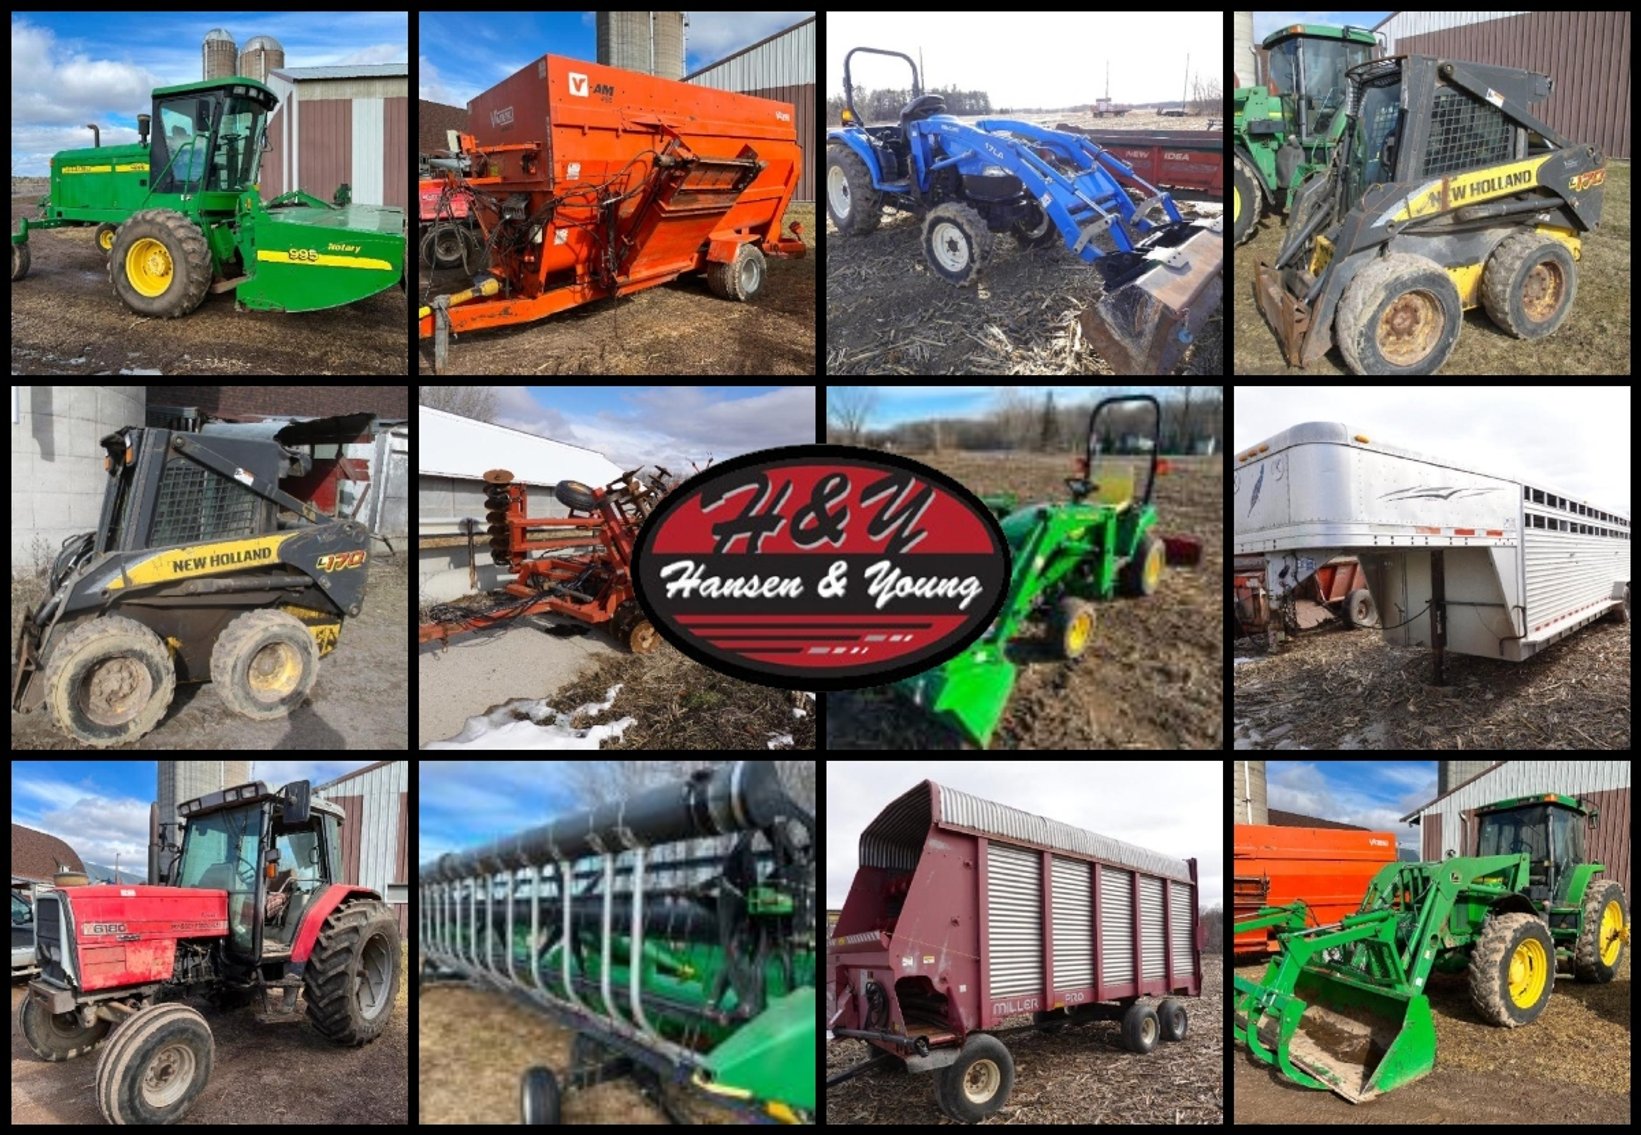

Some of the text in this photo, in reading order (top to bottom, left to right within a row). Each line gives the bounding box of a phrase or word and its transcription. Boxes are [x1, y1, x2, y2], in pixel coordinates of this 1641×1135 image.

[1126, 150, 1190, 161] NEW IDEA
[1427, 170, 1532, 208] NW HOLLAND
[288, 248, 318, 262] 995
[173, 547, 272, 573] NEW HOLLAND
[93, 924, 126, 933] 6180
[993, 998, 1039, 1015] MILLER
